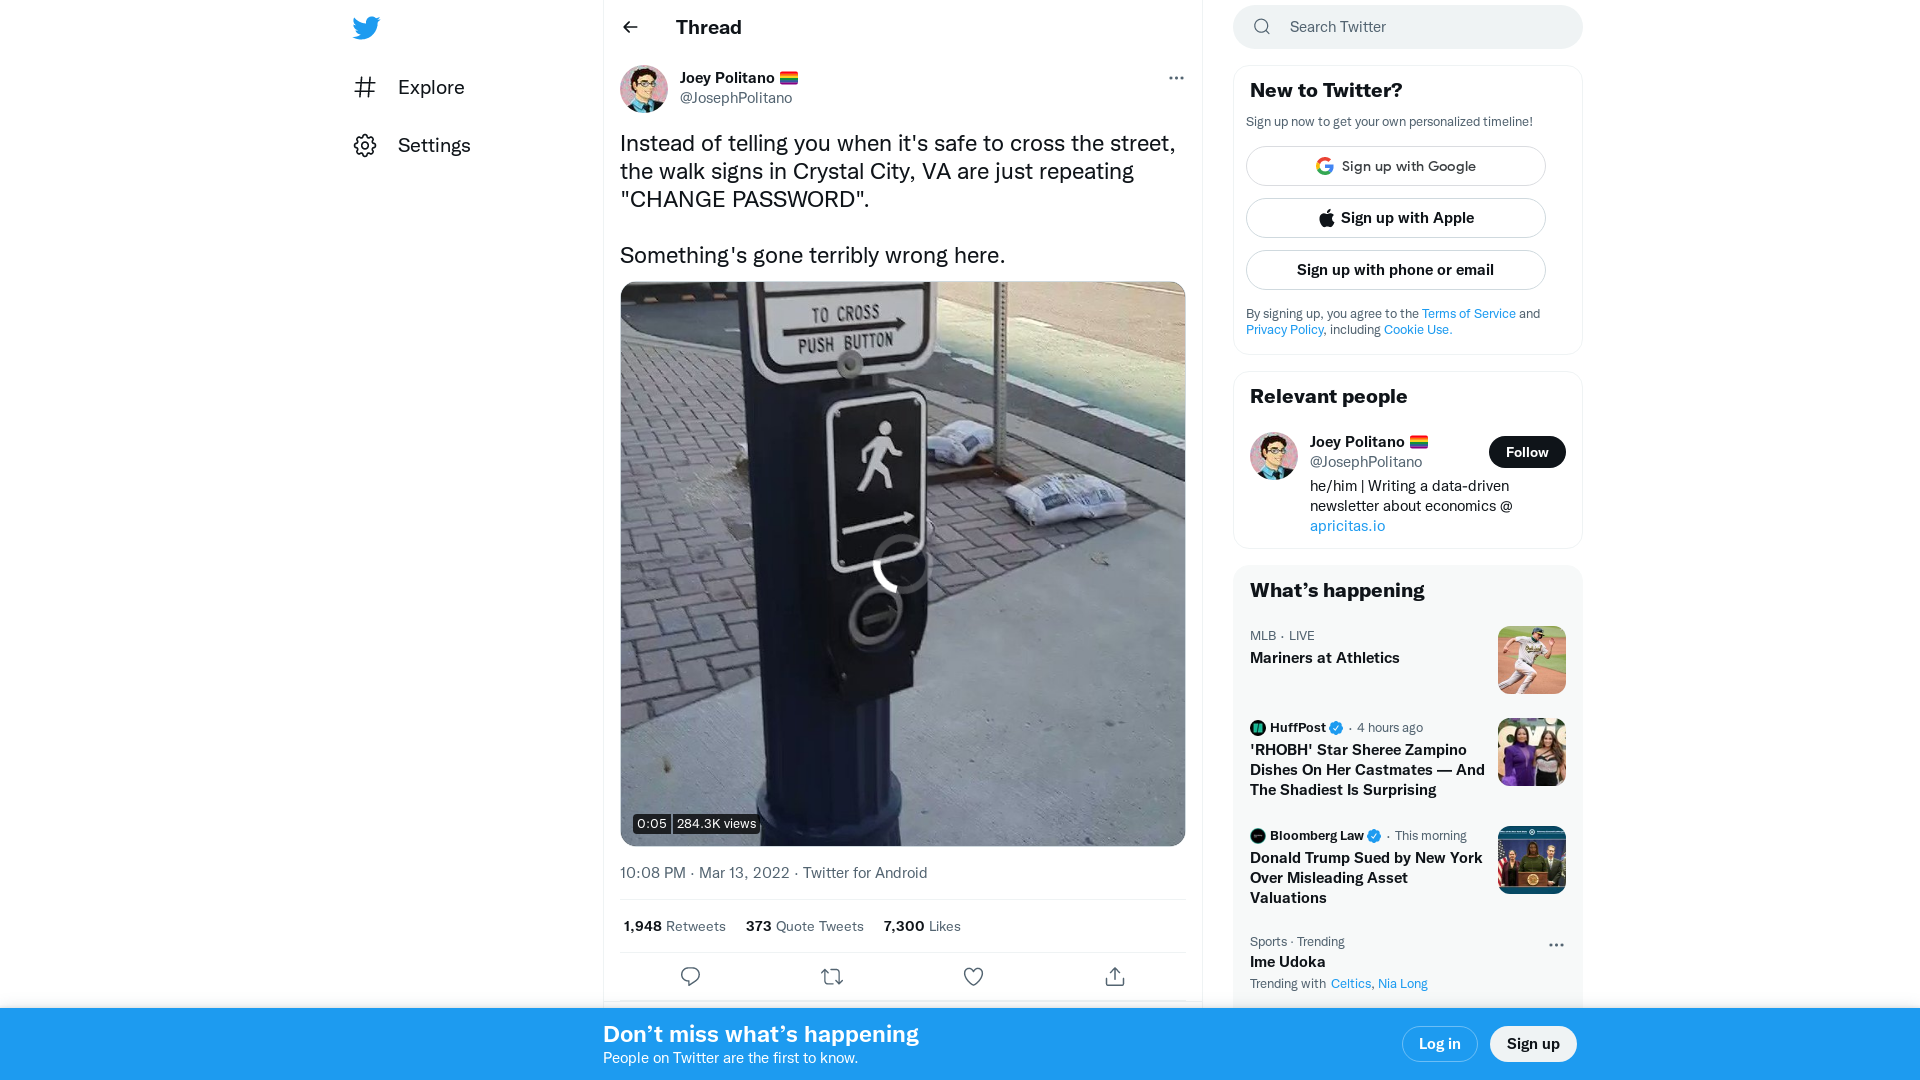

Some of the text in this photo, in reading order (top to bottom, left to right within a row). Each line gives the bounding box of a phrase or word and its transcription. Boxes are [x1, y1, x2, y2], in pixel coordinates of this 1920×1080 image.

[676, 20, 741, 34] Thread
[1290, 21, 1386, 32] Search Twitter
[680, 71, 774, 86] Joey Politano
[399, 80, 464, 98] Explore
[1251, 82, 1402, 97] New to Twitter?
[680, 92, 792, 106] @JosephPolitano
[1246, 116, 1271, 129] Sign
[1275, 119, 1288, 129] up
[1318, 117, 1330, 126] to
[1333, 117, 1351, 129] get
[1355, 119, 1379, 129] your
[1410, 116, 1480, 129] personalized
[1483, 116, 1532, 126] timeline!
[398, 137, 470, 156] Settings
[622, 134, 1174, 155] Instead of telling you when it's safe to cross the street,
[620, 162, 1134, 183] the walk signs in Crystal City, VA are just repeating
[622, 191, 868, 207] "CHANGE PASSWORD".
[620, 246, 1004, 267] Something's gone terribly wrong here.
[812, 304, 880, 324] TO CROSS
[1247, 308, 1540, 321] By signing up, you agree to the Terms of Service and
[1247, 324, 1452, 337] Privacy Policy, including Cookie Use.
[798, 332, 894, 354] PUSH BUTTON
[1251, 389, 1407, 407] Relevant people
[1507, 447, 1549, 457] Follow
[1311, 480, 1509, 494] he/him Writing a data-driven
[1311, 500, 1496, 511] newsletter about economics
[1310, 520, 1385, 534] apricitas.io
[1250, 582, 1425, 601] What’s happening
[1251, 631, 1314, 640] MLB LIVE
[1271, 723, 1326, 732] HuffPost
[1357, 723, 1423, 735] 4 hours ago
[1251, 743, 1466, 758] 'RHOBH' Star Sheree Zampino
[1251, 763, 1484, 775] Dishes On Her Castmates And
[1250, 783, 1437, 798] The Shadiest Is Surprising
[638, 819, 666, 828] 0:05
[677, 818, 756, 828] 284.3K views
[1271, 831, 1364, 843] Bloomberg Law
[1395, 830, 1467, 843] This morning
[1251, 852, 1482, 866] Donald Trump Sued by New York
[621, 867, 927, 880] 10:08 PM Mar 13, 2022 Twitter for Android
[1250, 871, 1408, 886] Over Misleading Asset
[1250, 891, 1326, 903] Valuations
[624, 921, 725, 933] 1,948 Retweets
[746, 921, 863, 933] 373 Quote Tweets
[884, 921, 960, 933] 7,300 Likes
[1250, 936, 1345, 949] Sports Trending
[1251, 956, 1325, 967] Ime Udoka
[1250, 978, 1428, 991] Trending with Celtics, Nia Long
[604, 1052, 857, 1066] People on Twitter are the first to know.
